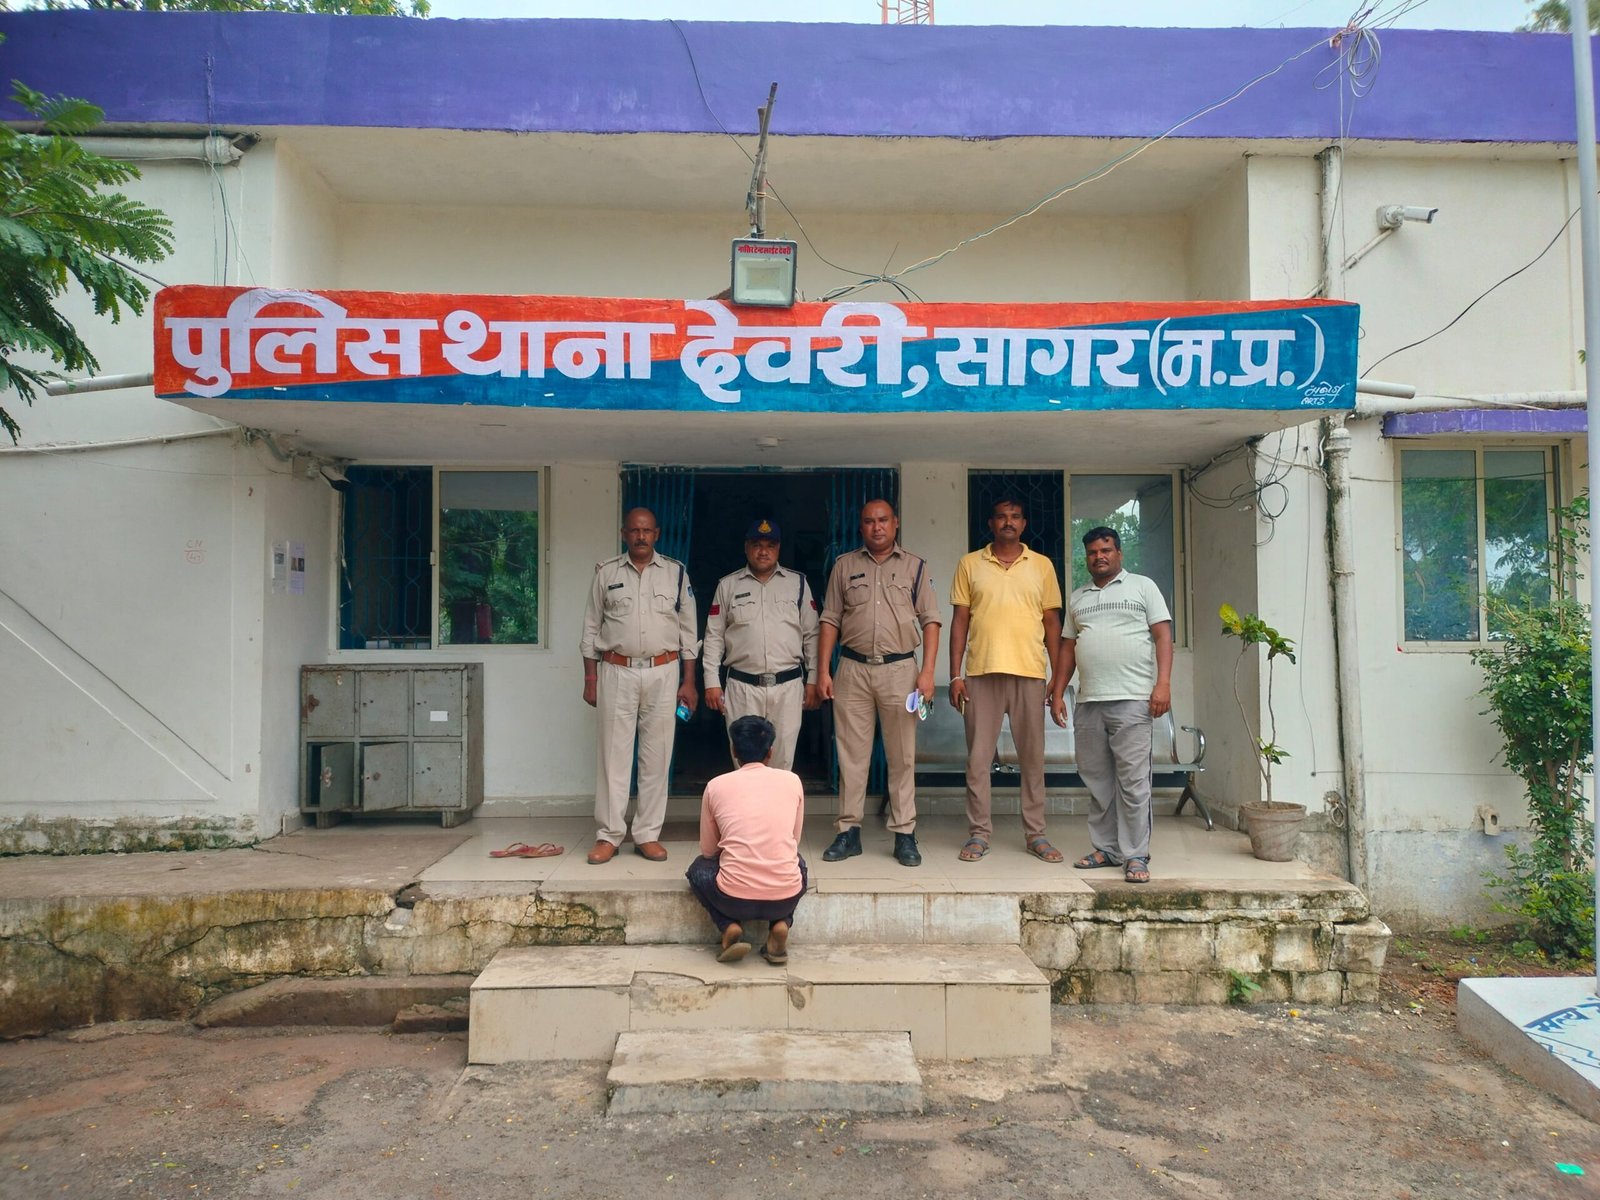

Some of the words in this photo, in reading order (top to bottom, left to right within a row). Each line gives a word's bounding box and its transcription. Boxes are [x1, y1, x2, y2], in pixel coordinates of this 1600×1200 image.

[164, 288, 438, 398] पुलिस
[441, 309, 675, 380] थाना
[934, 327, 1151, 387] सागर
[1301, 396, 1326, 406] ARTS
